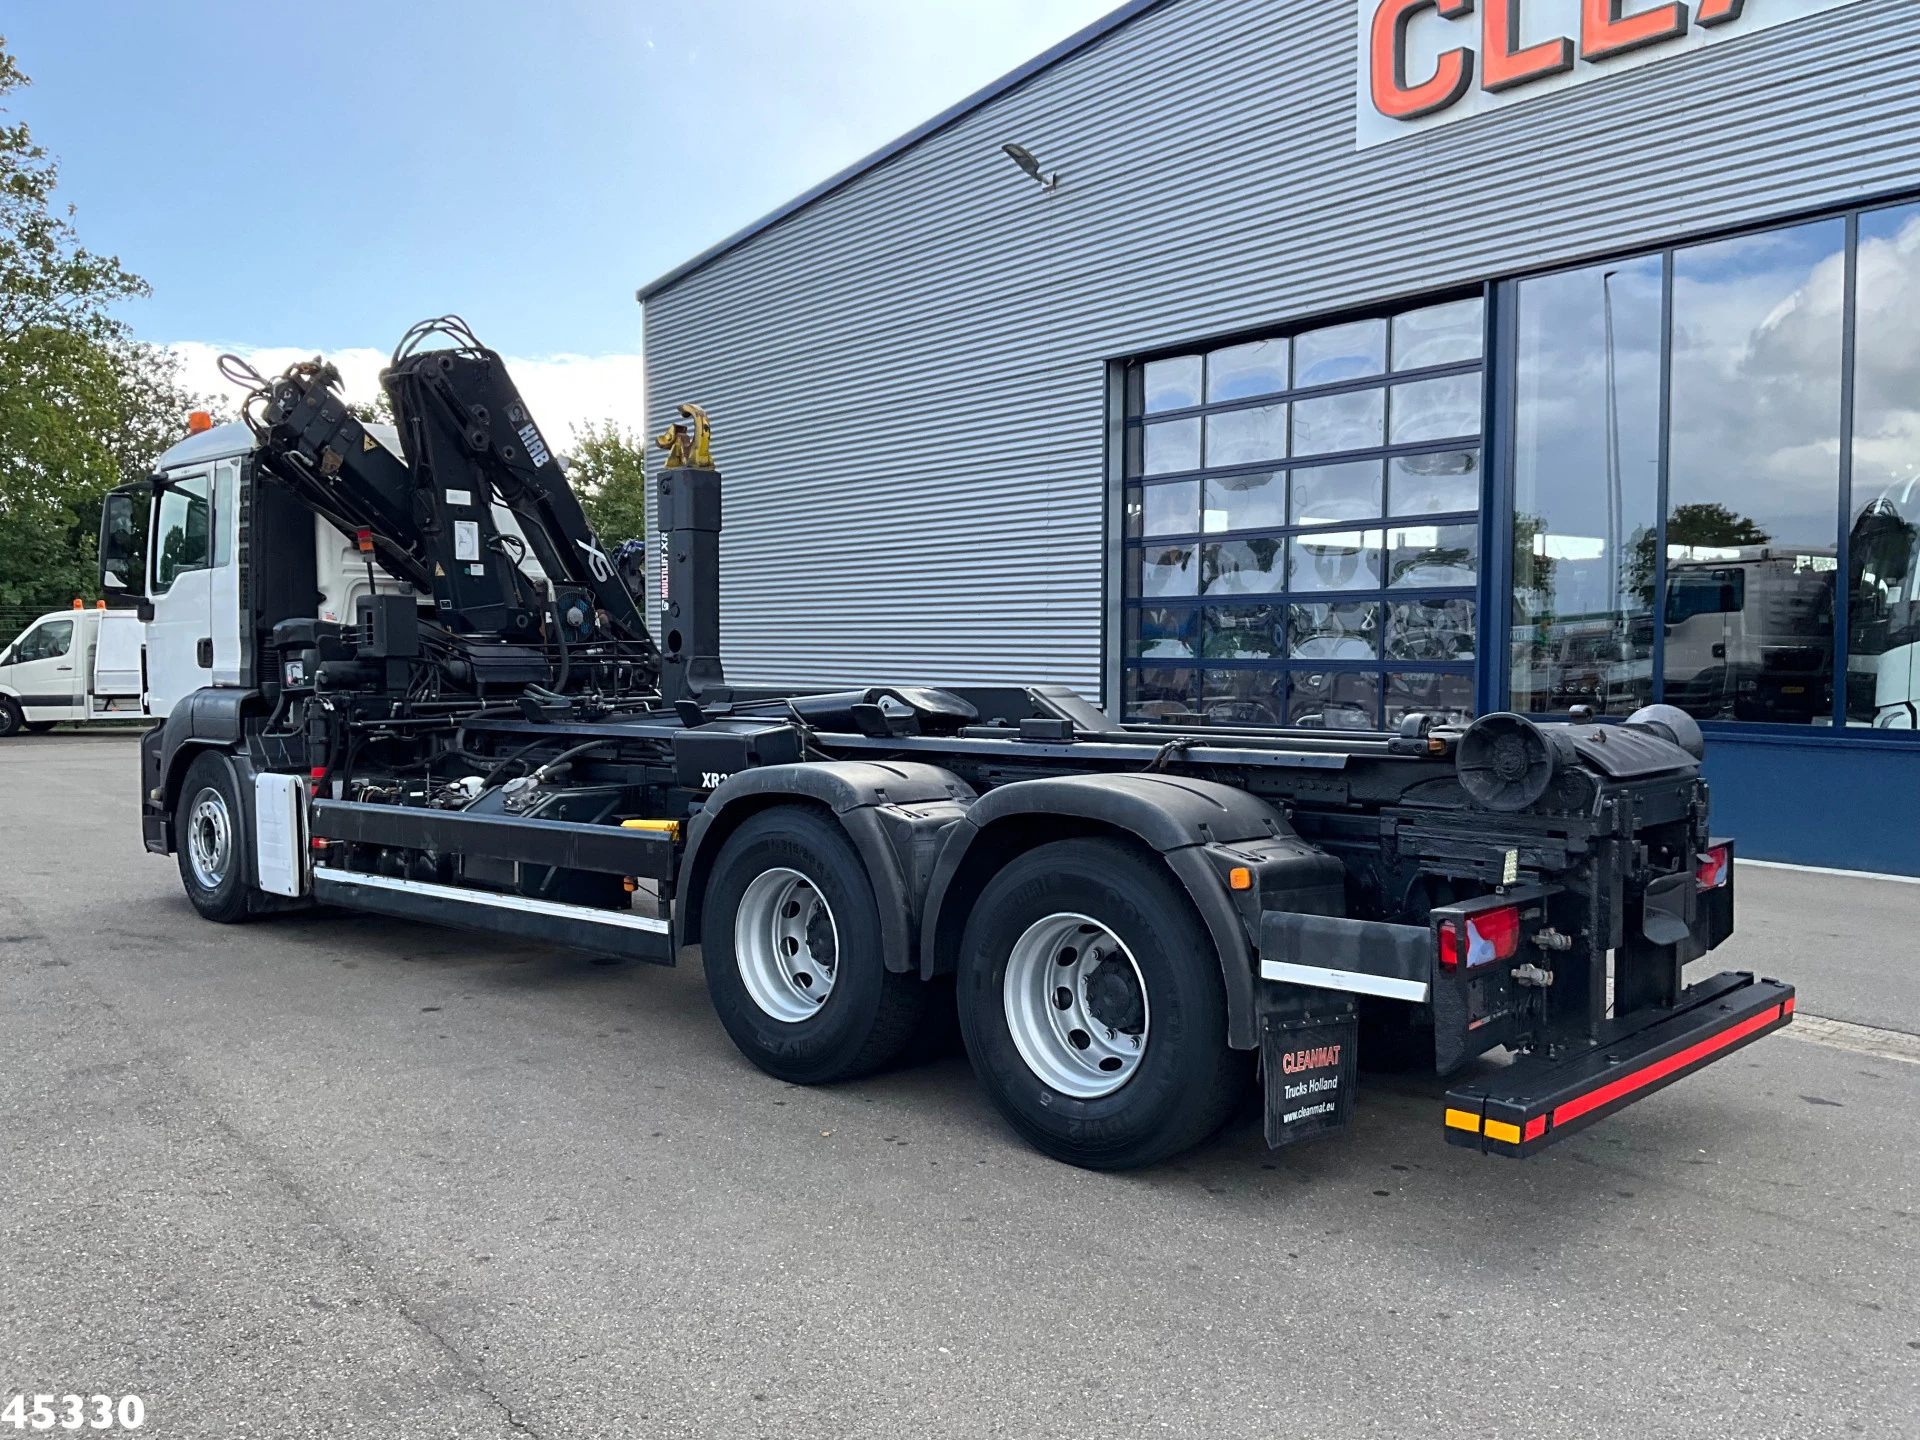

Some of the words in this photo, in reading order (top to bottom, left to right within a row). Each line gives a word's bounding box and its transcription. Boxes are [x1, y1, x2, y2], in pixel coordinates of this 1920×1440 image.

[1370, 0, 1744, 120] CL
[517, 422, 550, 468] HIAB
[661, 532, 669, 551] XR
[661, 552, 669, 599] MULTILIFT
[702, 772, 735, 788] XR
[1282, 1045, 1341, 1074] CLEANMAT
[1284, 1082, 1308, 1099] Trucks
[1308, 1075, 1338, 1093] Holland
[1283, 1102, 1335, 1123] www.cleanmat.eu
